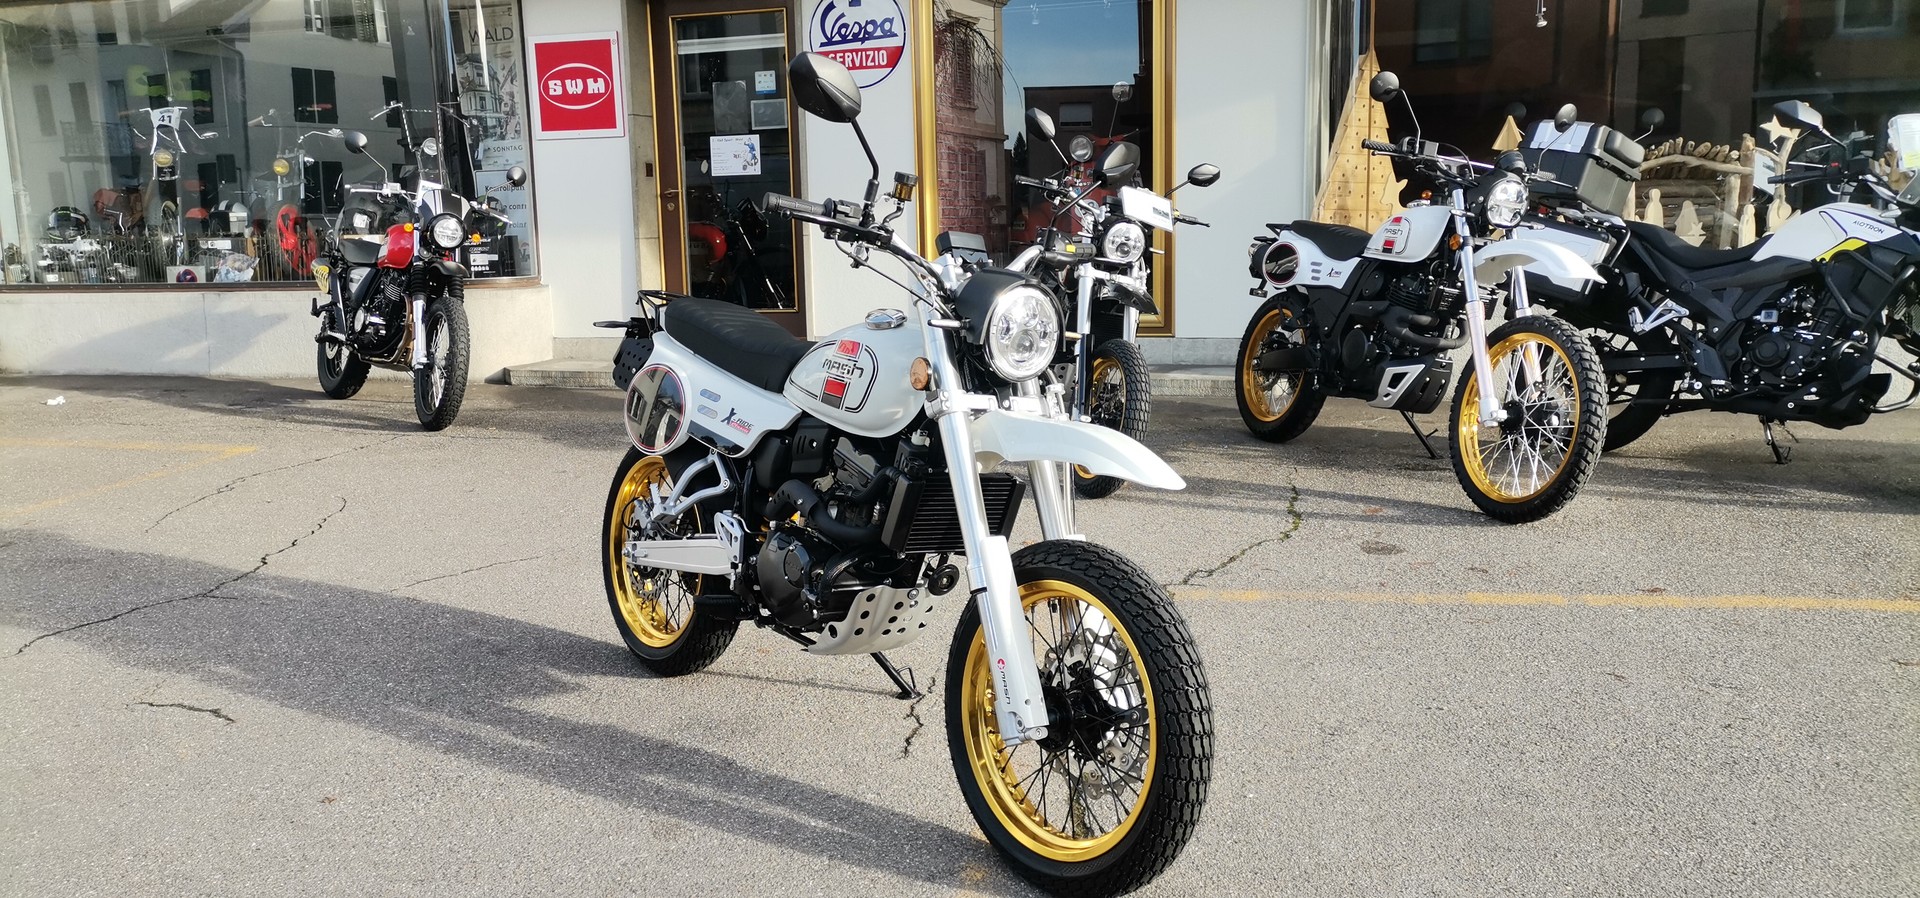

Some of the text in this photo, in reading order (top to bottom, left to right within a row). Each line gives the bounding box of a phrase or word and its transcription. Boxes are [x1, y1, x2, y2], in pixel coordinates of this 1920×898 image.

[819, 0, 898, 48] Vespa
[468, 27, 514, 43] WALD
[548, 77, 606, 96] SWM
[158, 114, 173, 124] 41
[1852, 220, 1885, 234] MOTRON
